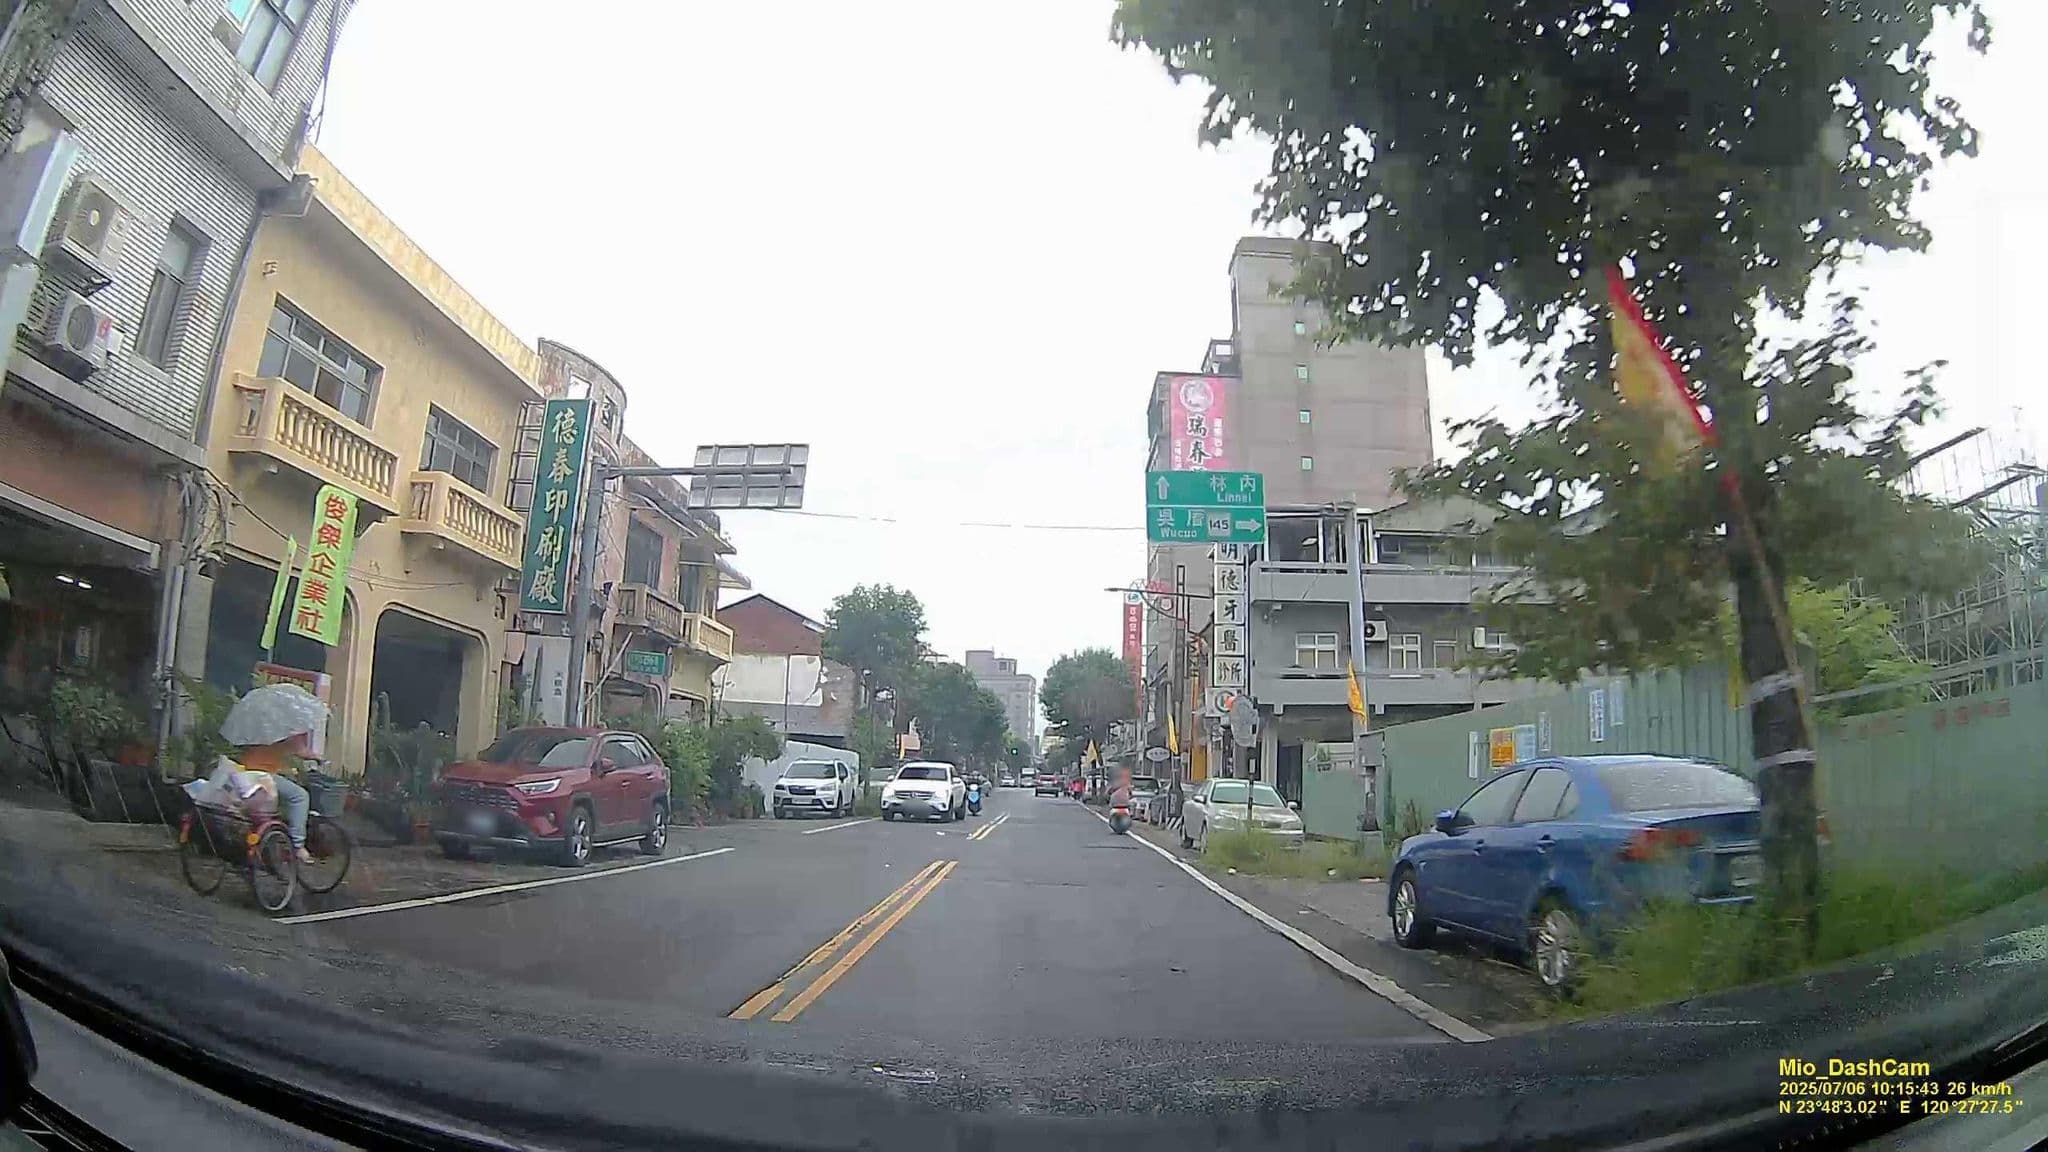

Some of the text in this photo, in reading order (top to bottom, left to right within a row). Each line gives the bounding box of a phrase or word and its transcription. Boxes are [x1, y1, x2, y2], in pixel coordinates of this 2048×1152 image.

[1209, 474, 1256, 492] 林內
[528, 407, 578, 605] 德春印刷廠
[1217, 492, 1251, 503] Linnei
[1160, 528, 1198, 538] Wucuo
[1209, 519, 1229, 530] 145
[297, 494, 348, 635] 俊傑企業社
[1218, 542, 1242, 682] 明德牙醫診所
